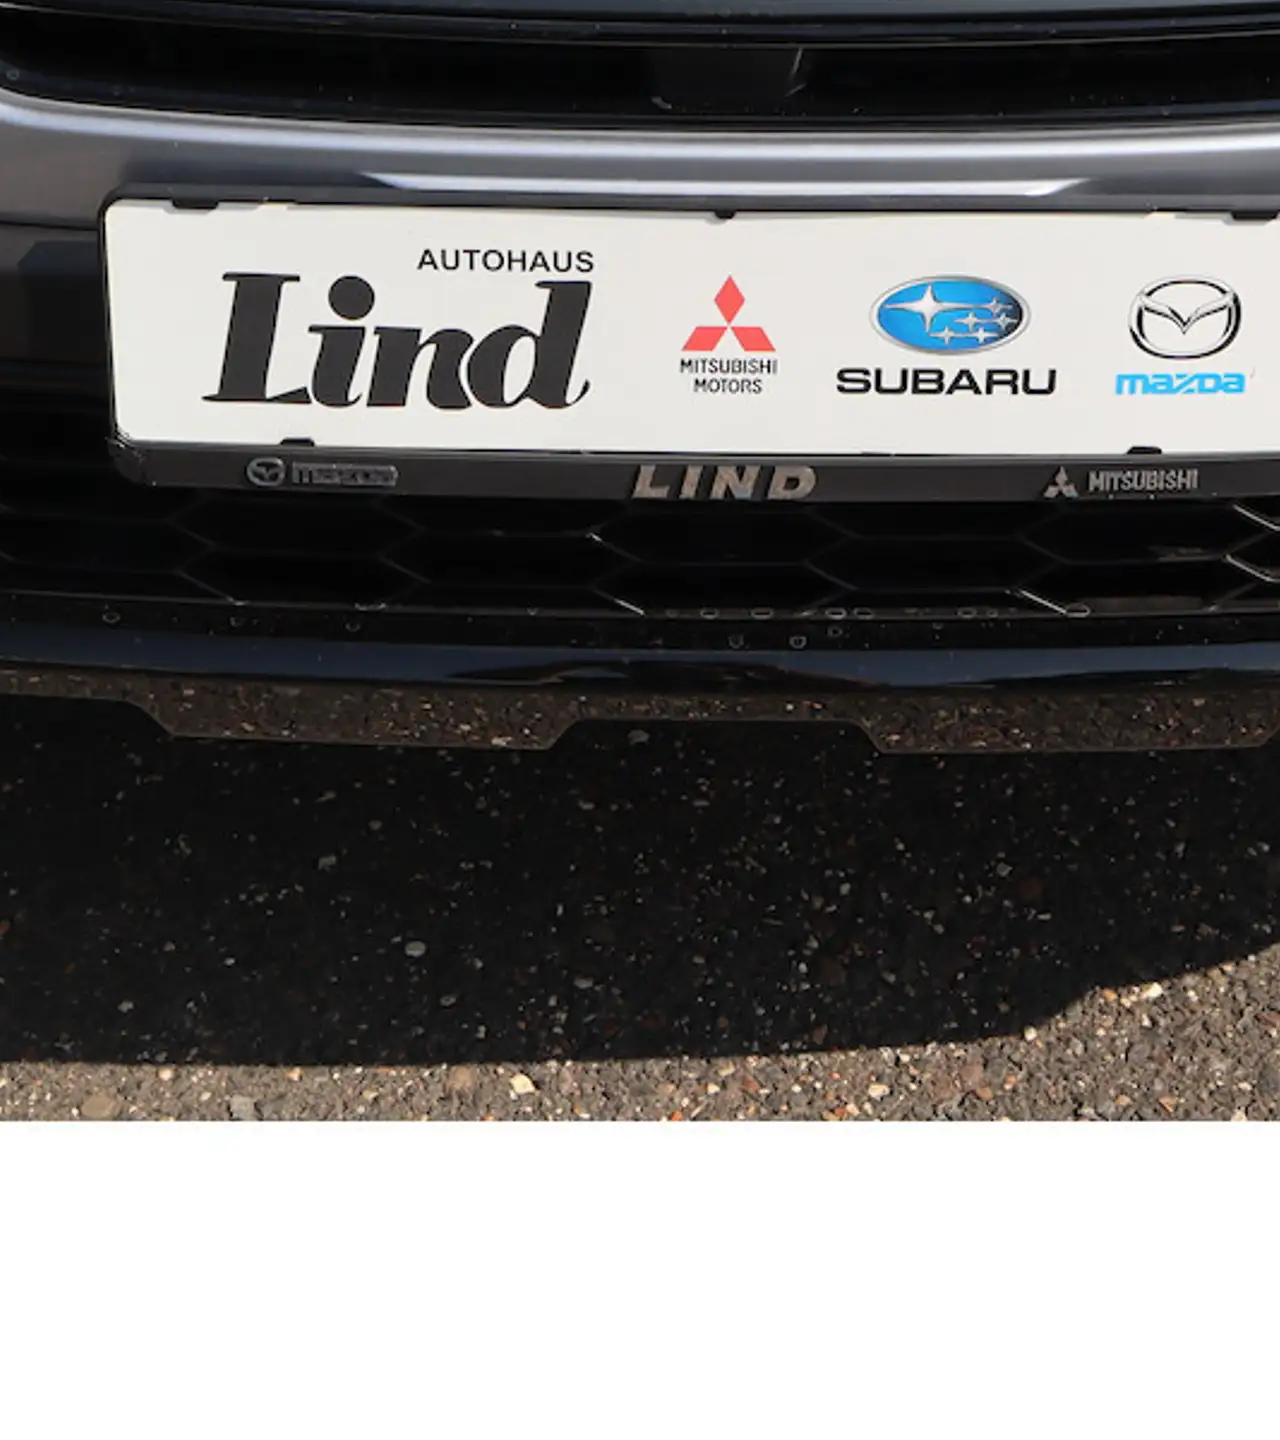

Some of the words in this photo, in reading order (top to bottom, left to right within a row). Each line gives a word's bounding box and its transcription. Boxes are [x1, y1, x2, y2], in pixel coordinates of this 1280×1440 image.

[417, 248, 595, 273] AUTOHAUS
[201, 271, 593, 410] Lind
[680, 357, 777, 375] MITSUBISHI
[693, 378, 763, 395] MOTORS
[836, 367, 1057, 396] SUBARU
[1114, 371, 1247, 396] mazda
[632, 463, 818, 499] LIND
[1088, 468, 1200, 492] MITSUBISHI
